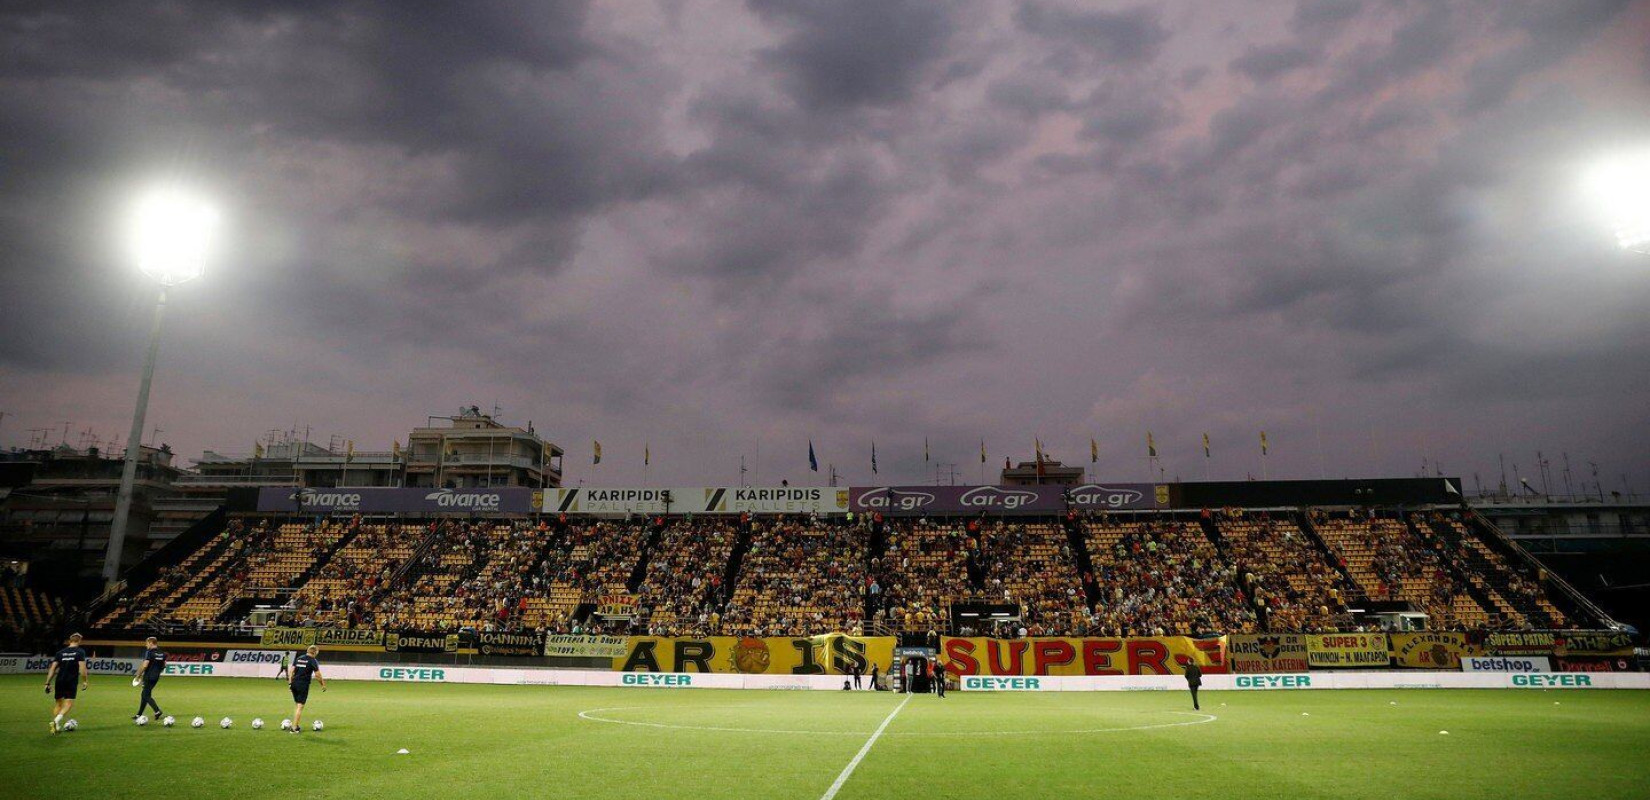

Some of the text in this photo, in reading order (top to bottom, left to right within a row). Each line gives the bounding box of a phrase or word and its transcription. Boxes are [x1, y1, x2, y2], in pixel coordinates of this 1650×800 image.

[301, 493, 361, 506] avance
[437, 493, 499, 507] avance
[588, 490, 670, 501] KARIPIDIS
[736, 489, 820, 501] KARIPIDIS
[588, 502, 669, 511] PALLETS
[736, 502, 820, 511] PALLETS
[325, 629, 374, 640] ARIDEA
[479, 632, 543, 646] IOANNINA
[1286, 636, 1297, 644] OR
[400, 637, 444, 648] ORFANI
[1322, 636, 1368, 648] SUPER 3
[1235, 643, 1259, 653] ARIS
[1280, 645, 1306, 653] DEATH
[166, 664, 213, 675] EYER
[380, 669, 444, 680] GEYER
[622, 674, 691, 686] GEYER
[966, 677, 1039, 689] GEYER
[1236, 675, 1311, 688] GEYER
[1512, 674, 1591, 687] GEYER
